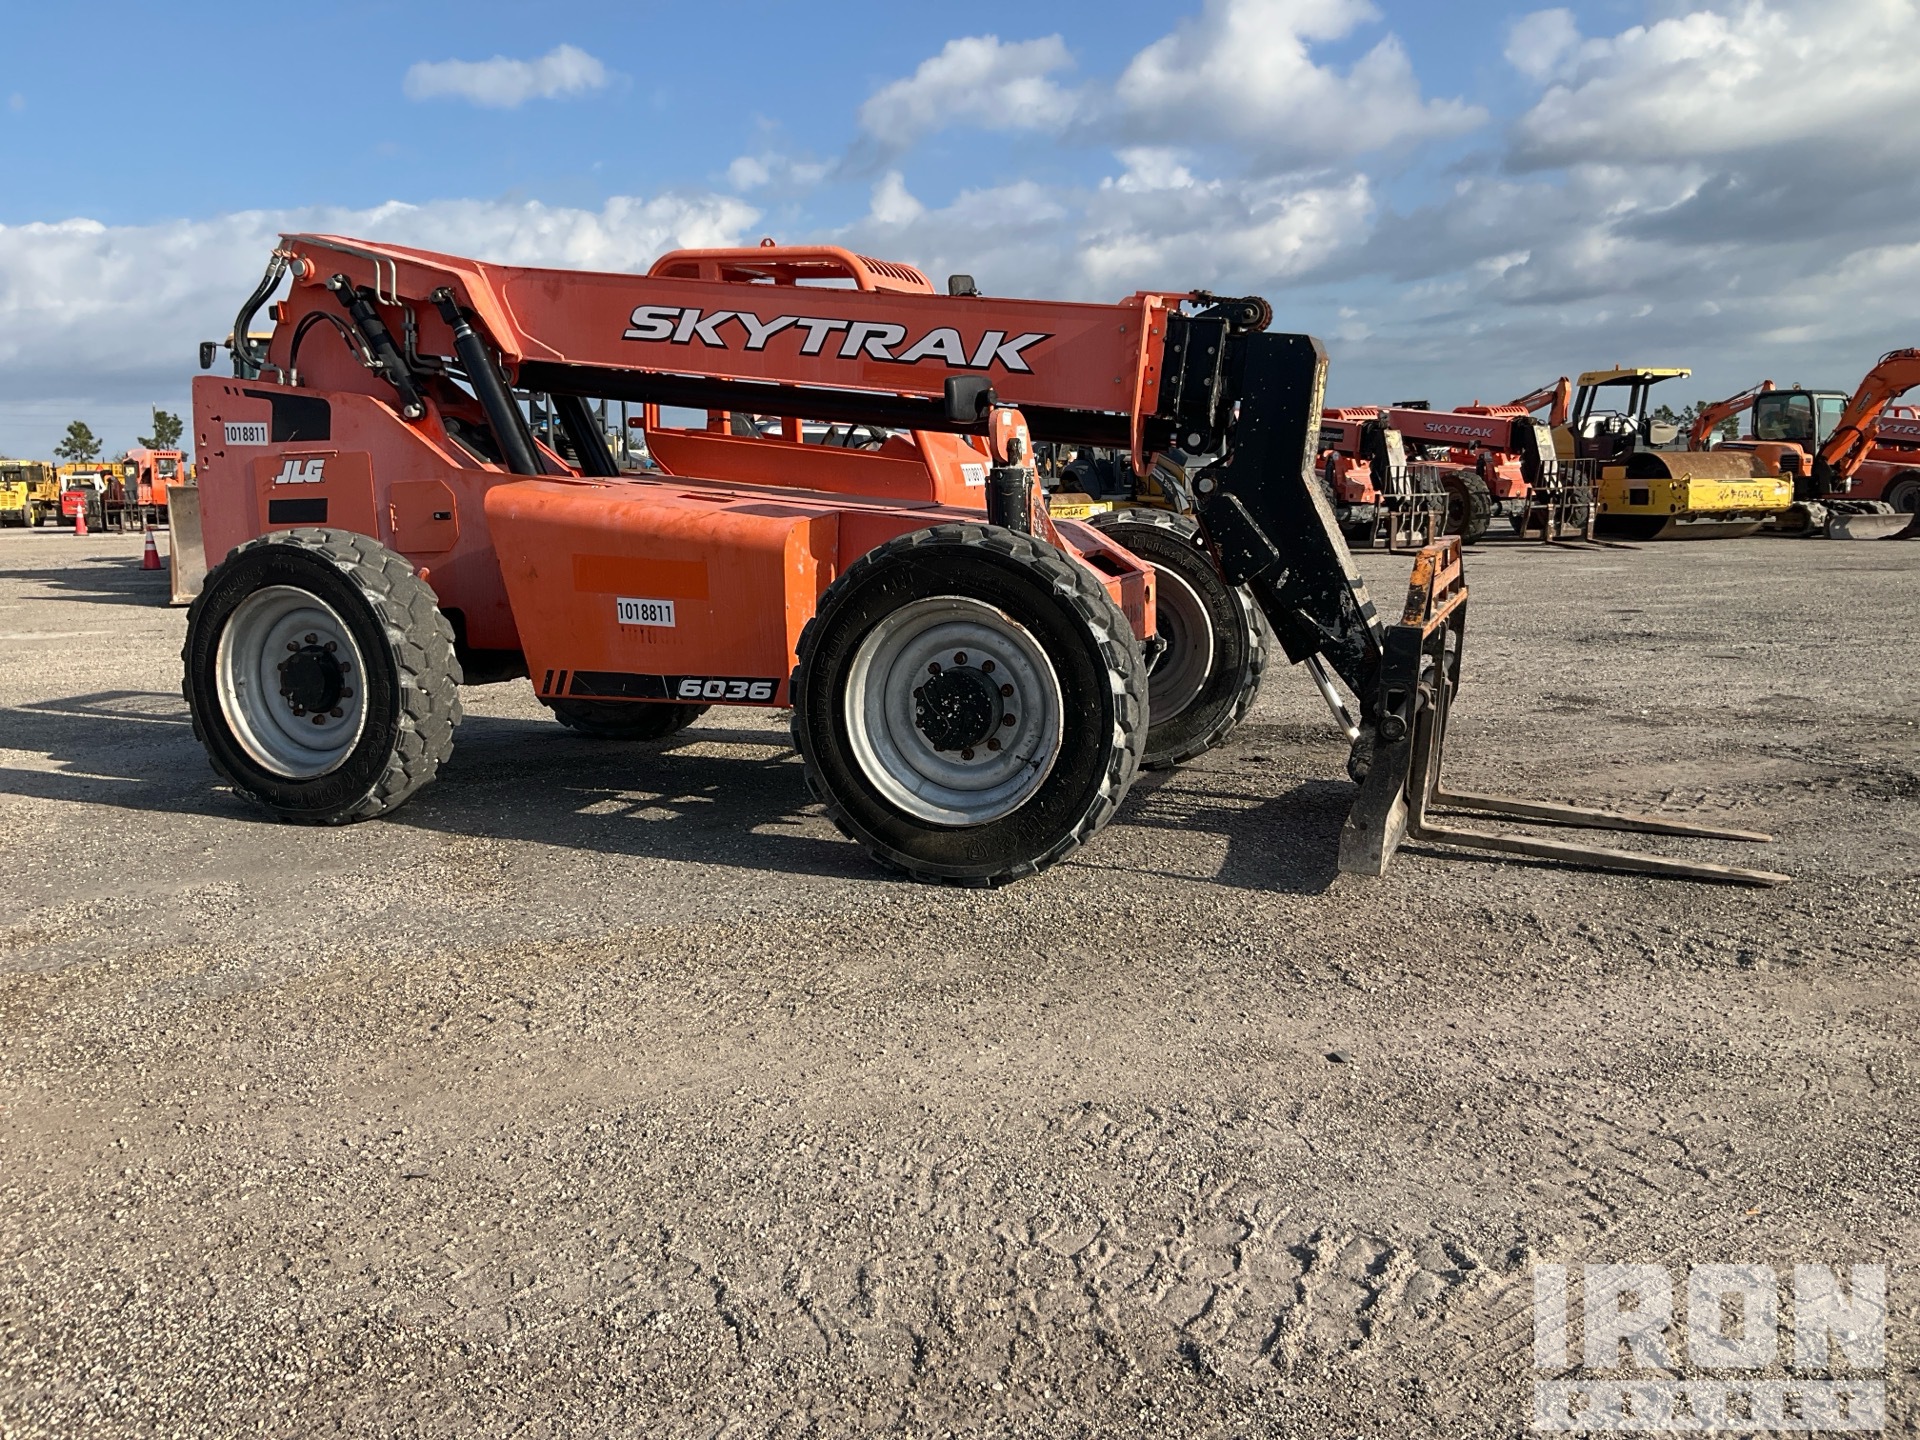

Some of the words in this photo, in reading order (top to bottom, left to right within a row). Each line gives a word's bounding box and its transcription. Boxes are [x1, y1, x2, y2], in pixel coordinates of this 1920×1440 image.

[622, 305, 1055, 374] SKYTRAK
[225, 426, 266, 442] 1018811
[1425, 422, 1493, 438] SKYTRAK
[275, 459, 325, 484] JLG
[617, 602, 671, 623] 1018811
[678, 679, 772, 700] 6036
